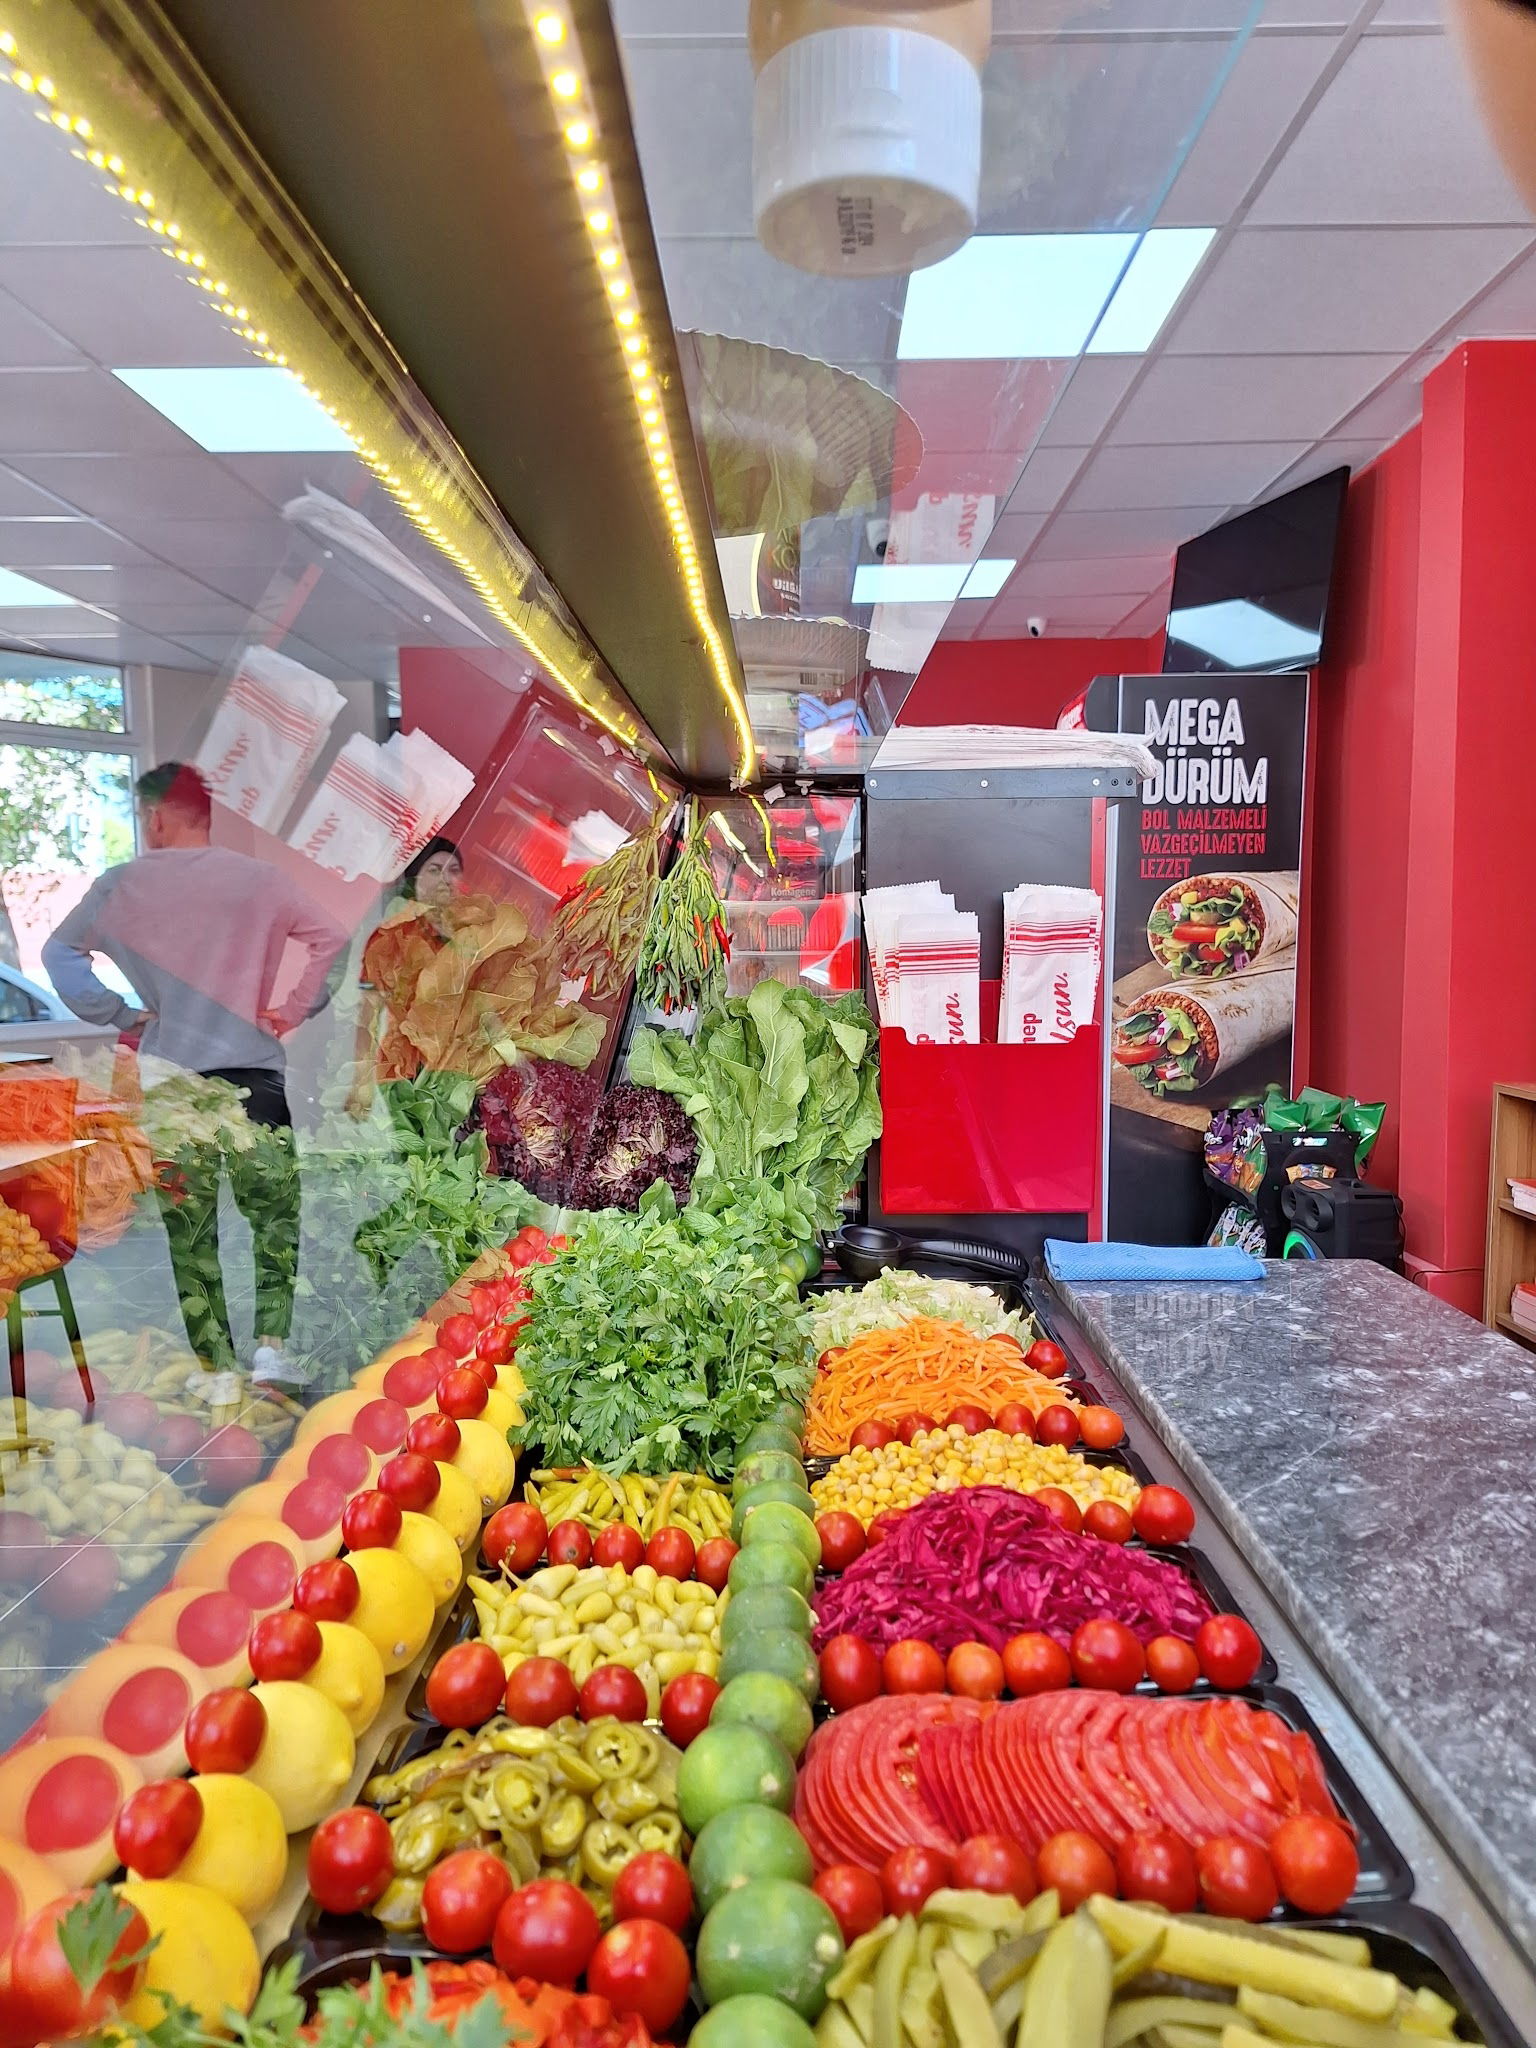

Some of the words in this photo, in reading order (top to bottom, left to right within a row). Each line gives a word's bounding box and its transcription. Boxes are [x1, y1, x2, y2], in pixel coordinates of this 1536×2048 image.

[1143, 697, 1246, 747] MEGA
[1141, 747, 1268, 805] DÜRÜM
[1141, 809, 1171, 831] BOL
[1177, 804, 1268, 831] MALZEMELİ
[1140, 830, 1267, 856] VAZGEÇİLMEYEN
[1140, 858, 1192, 879] LEZZET
